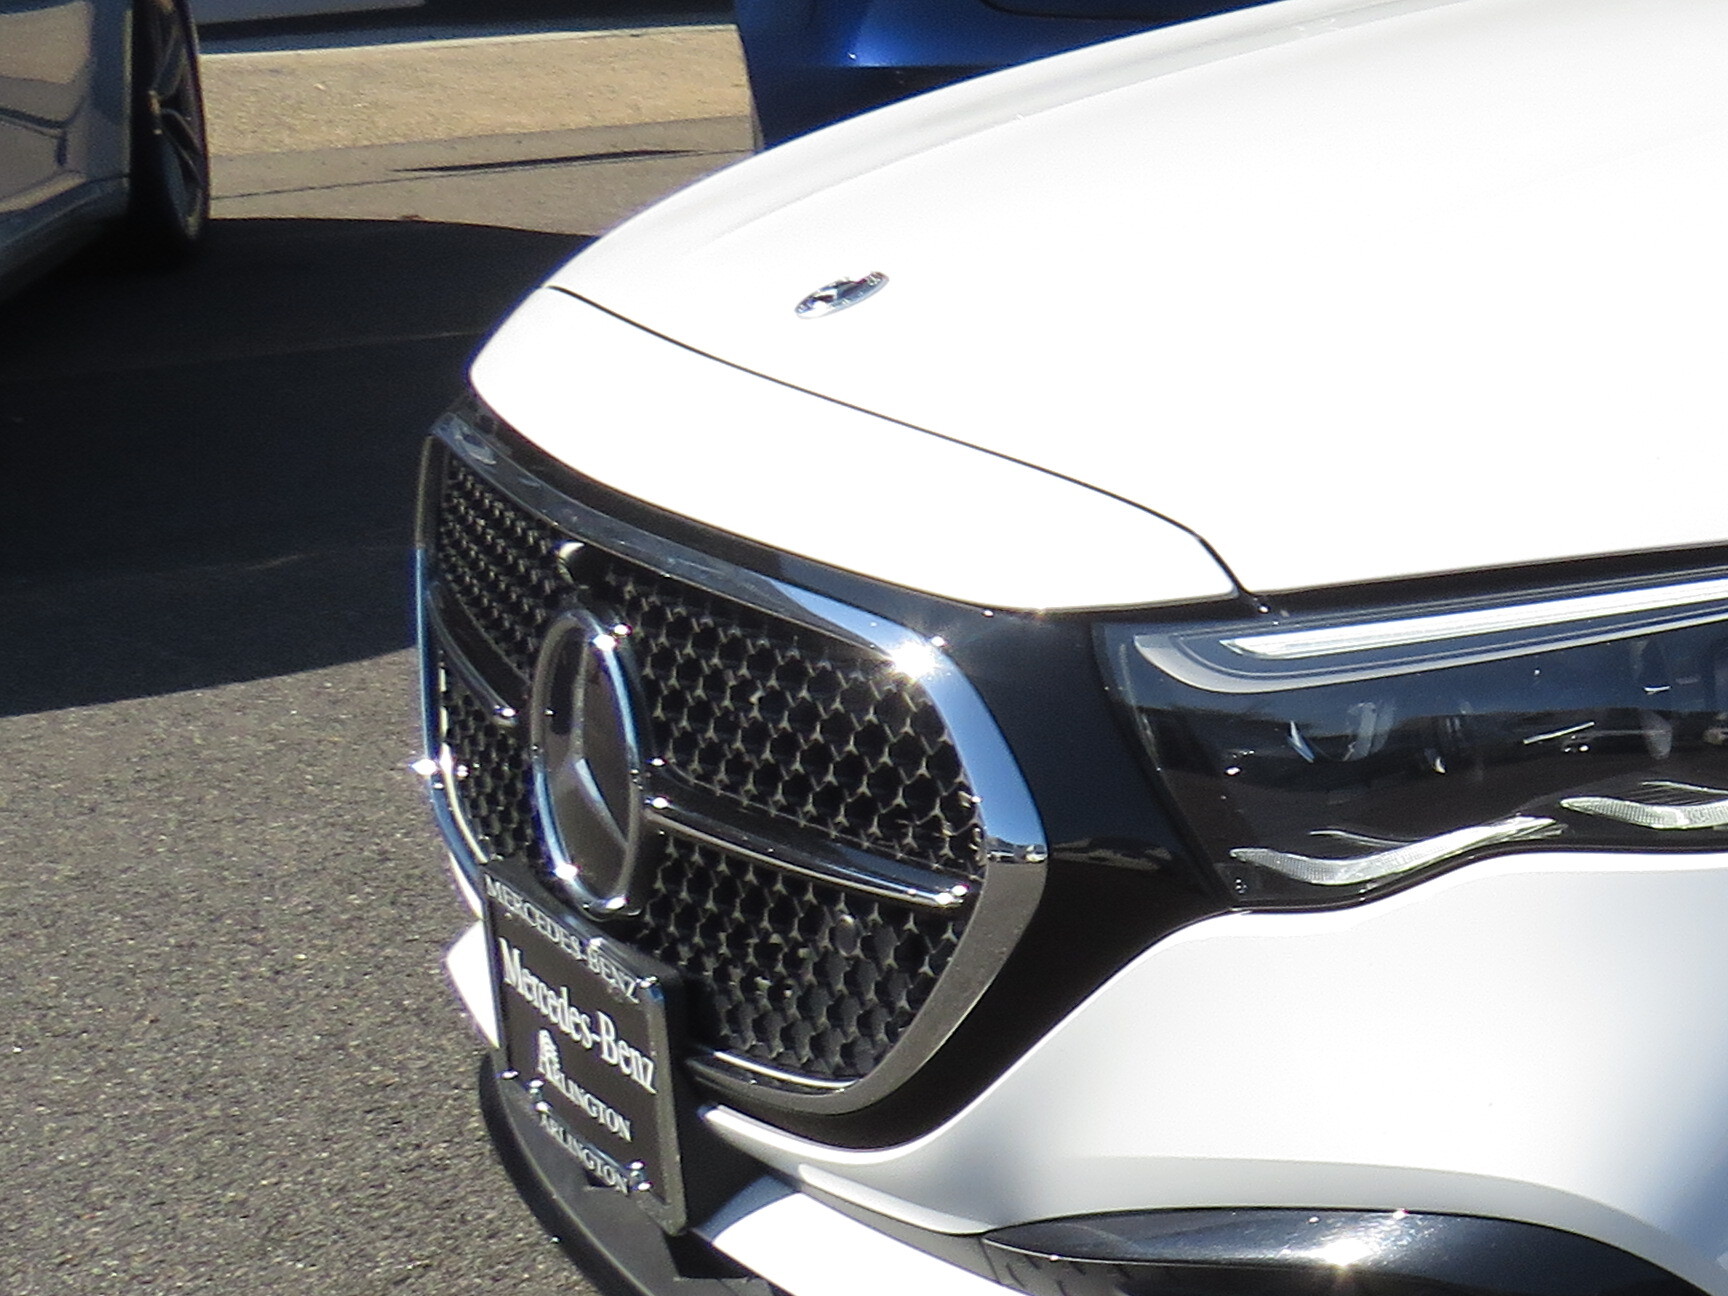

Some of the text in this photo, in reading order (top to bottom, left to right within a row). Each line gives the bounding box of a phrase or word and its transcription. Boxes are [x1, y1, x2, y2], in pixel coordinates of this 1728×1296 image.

[484, 873, 640, 1005] MERCEDES-BENZ
[499, 936, 657, 1095] Mercedes-Benz
[540, 1112, 630, 1196] ARLINGTON
